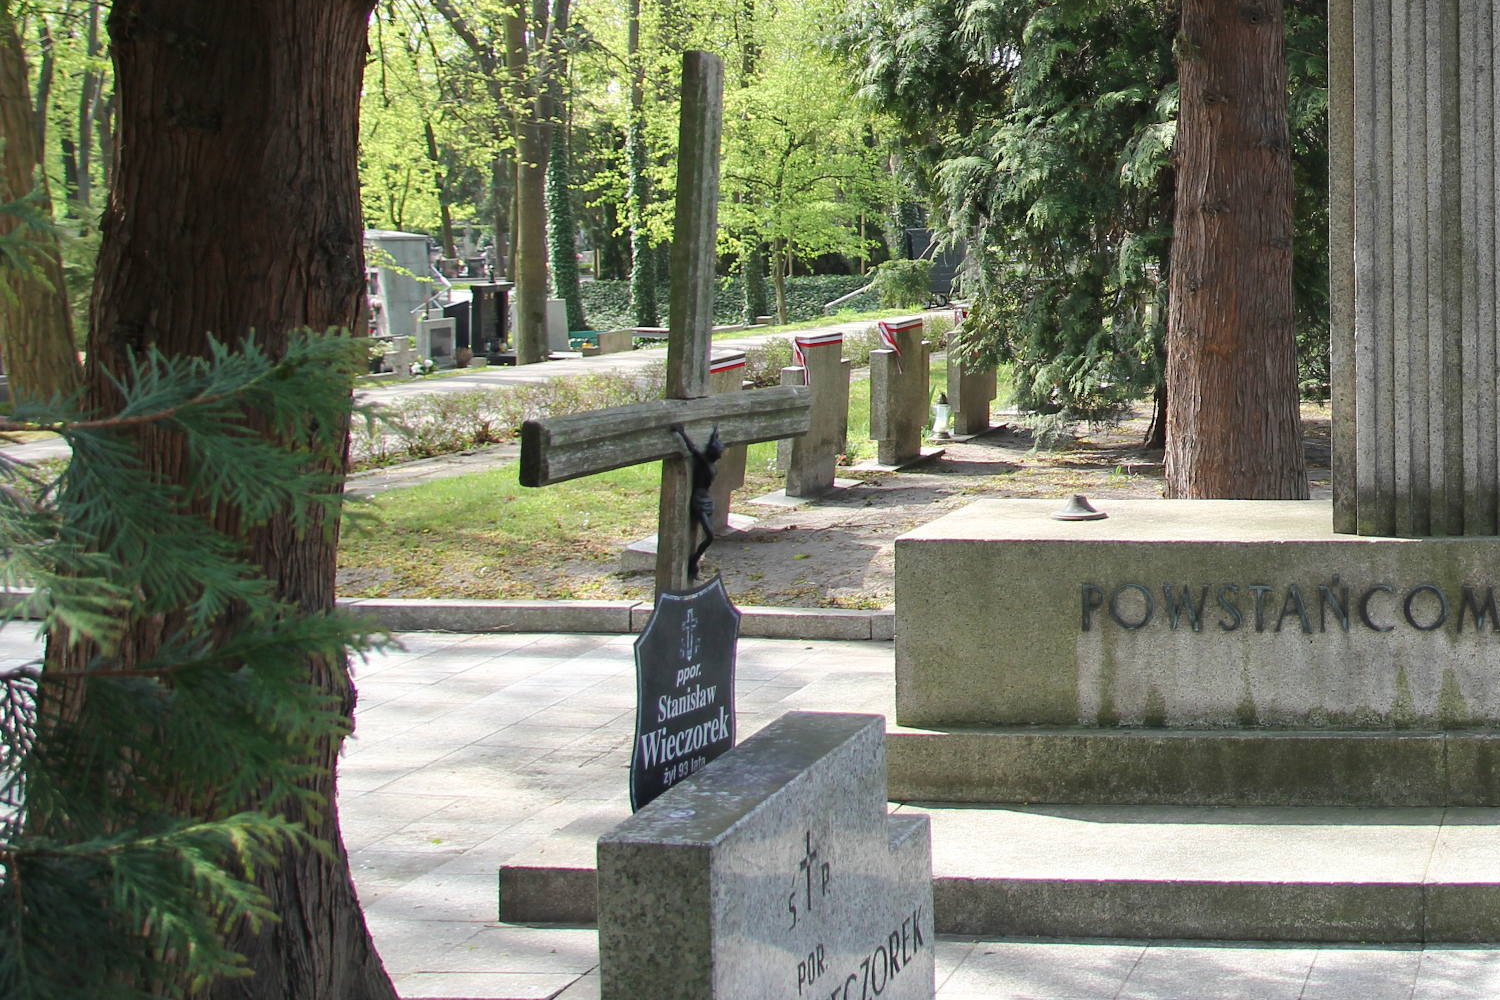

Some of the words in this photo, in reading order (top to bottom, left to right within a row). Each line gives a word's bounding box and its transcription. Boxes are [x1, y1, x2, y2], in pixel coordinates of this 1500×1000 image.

[676, 663, 702, 687] ppor.
[658, 684, 717, 722] Stanisław
[641, 706, 730, 770] Wieczorek
[678, 760, 689, 778] 93
[831, 904, 924, 1000] CZOREK
